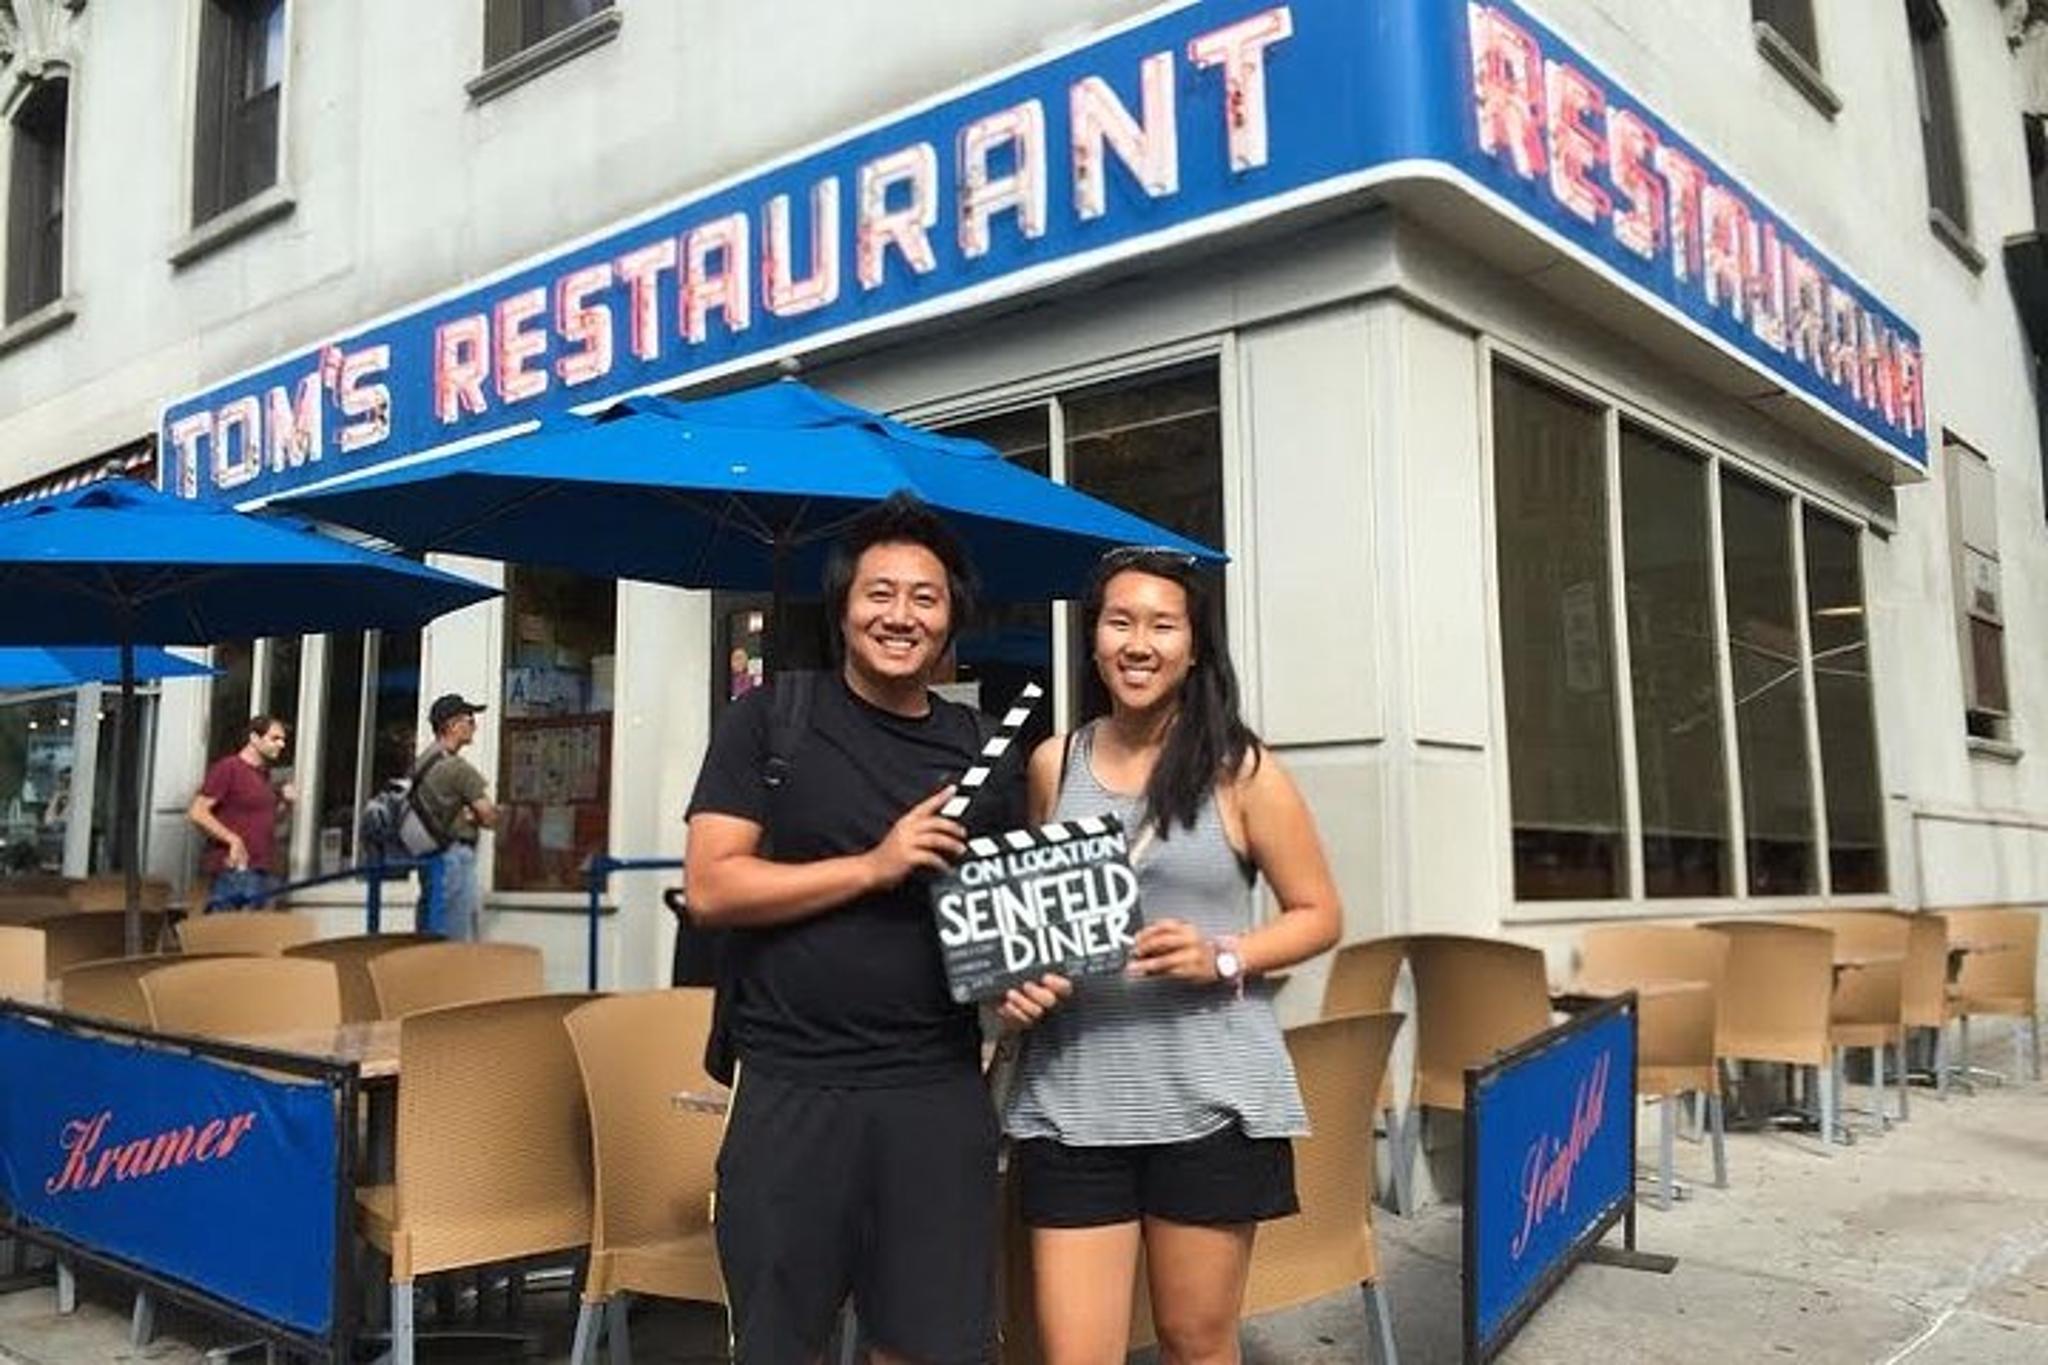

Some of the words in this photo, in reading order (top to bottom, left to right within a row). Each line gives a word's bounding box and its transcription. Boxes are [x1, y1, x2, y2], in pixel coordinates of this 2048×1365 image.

[169, 343, 391, 499] TOM'S
[434, 6, 1294, 424] RESTAURANT
[1467, 3, 1924, 437] RESTAURANT
[961, 857, 1003, 885] ON
[1009, 832, 1126, 876] LOCATION
[939, 862, 1138, 946] SEINFELD
[1003, 911, 1136, 973] DINER
[45, 1110, 257, 1195] Kramer
